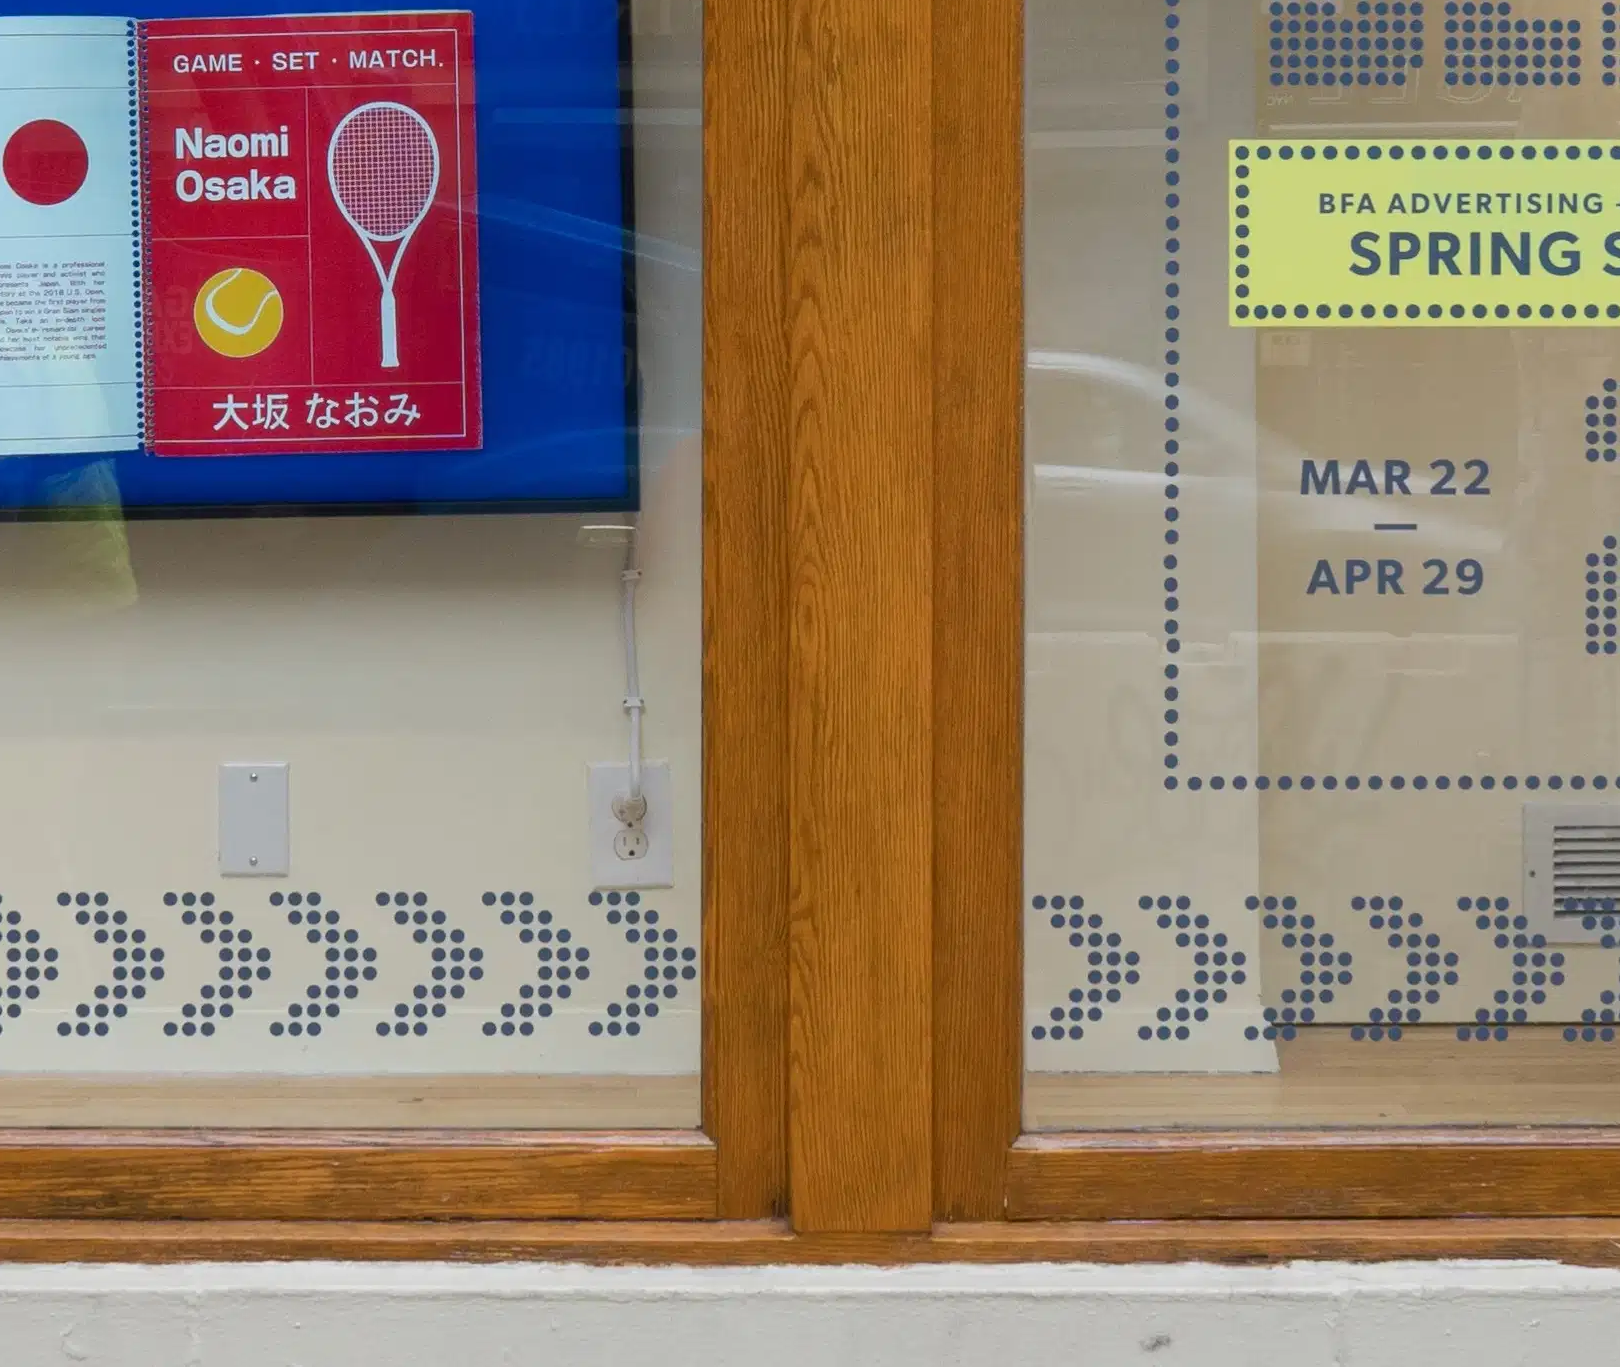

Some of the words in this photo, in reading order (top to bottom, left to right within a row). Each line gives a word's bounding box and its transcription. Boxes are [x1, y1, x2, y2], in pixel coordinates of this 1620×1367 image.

[173, 53, 243, 74] GAME
[272, 51, 320, 71] SET
[348, 48, 444, 69] MATCH.
[175, 125, 290, 159] Naomi
[175, 168, 296, 204] Osaka
[1318, 192, 1377, 215] BFA
[1386, 192, 1604, 215] ADVERTISING
[1347, 230, 1583, 278] SPRING
[212, 392, 291, 432] 大坂
[305, 390, 422, 431] なおみ
[1298, 460, 1412, 495] MAR
[1429, 460, 1491, 495] 22
[1306, 559, 1403, 595] APR
[1422, 559, 1484, 595] 29
